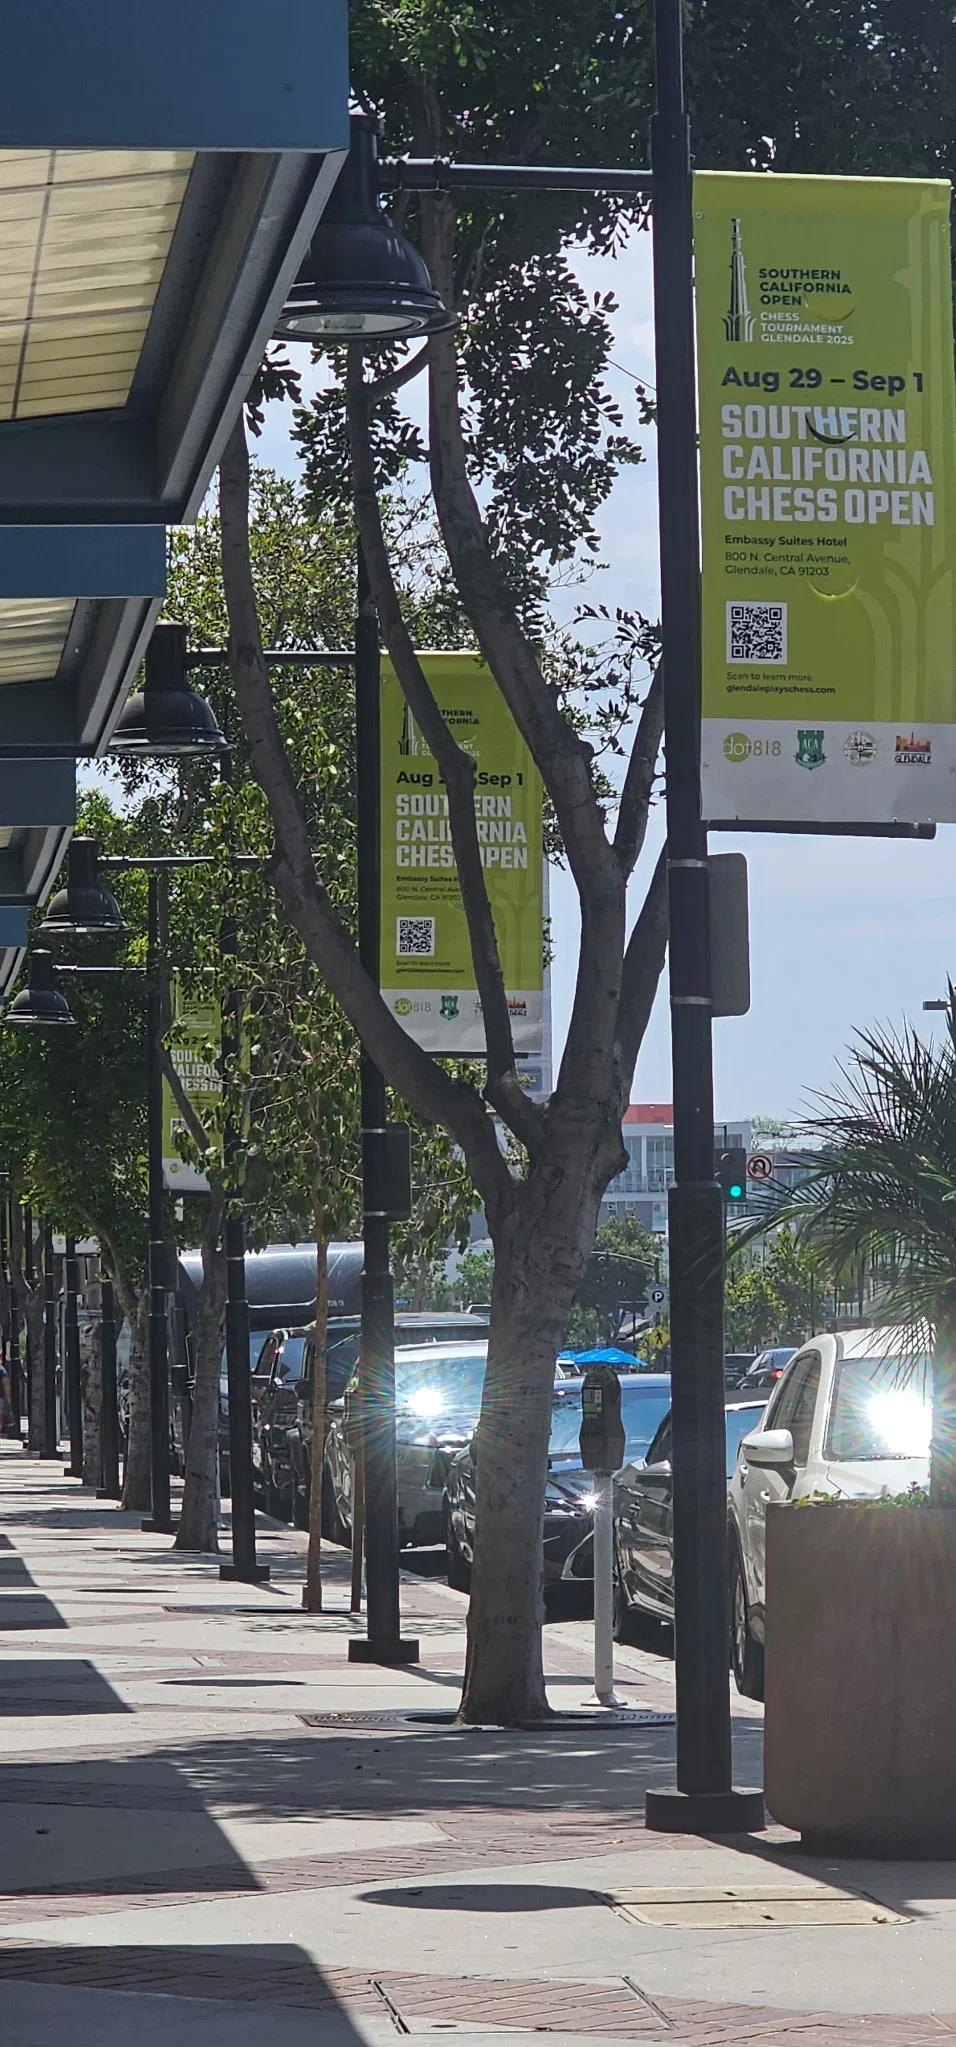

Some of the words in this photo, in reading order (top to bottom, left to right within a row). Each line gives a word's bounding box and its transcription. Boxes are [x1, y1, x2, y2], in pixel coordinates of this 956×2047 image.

[758, 268, 841, 280] SOUTHERN
[759, 281, 852, 295] CALIFORNIA
[760, 294, 802, 306] OPEN
[760, 311, 800, 322] CHESS
[760, 322, 844, 334] TOURNAMENT
[761, 333, 824, 344] GLENDALE
[826, 335, 854, 345] 2025
[721, 366, 780, 393] Aug
[788, 368, 823, 389] 29
[852, 370, 906, 397] Sep
[913, 372, 924, 393] 1
[721, 404, 907, 443] SOUTHERN
[722, 444, 933, 485] CALIFORNIA
[723, 485, 837, 522] CHESS
[844, 488, 935, 527] OPEN
[725, 535, 775, 547] Embassy
[778, 536, 814, 547] Suites
[816, 537, 848, 547] Hotel
[725, 551, 747, 561] 800
[749, 552, 762, 561] N.
[763, 553, 804, 563] Central
[806, 553, 852, 565] Avenue,
[725, 564, 778, 577] Glendale,
[779, 566, 796, 576] CA
[798, 566, 830, 577] 91203
[726, 672, 749, 681] Scan
[751, 672, 761, 681] to
[763, 672, 787, 681] learn
[788, 673, 813, 682] more
[726, 684, 836, 695] glendaleplayschess.com
[441, 709, 473, 717] THERN
[724, 737, 781, 757] dot818
[802, 738, 819, 750] ACA
[894, 754, 932, 765] GLENDALE
[396, 771, 433, 788] Aug
[478, 772, 512, 788] Sep
[516, 772, 523, 786] 1
[396, 793, 512, 818] SOUTERN
[396, 819, 528, 844] CALIRNIA
[396, 844, 458, 868] CHES
[654, 1291, 663, 1302] P
